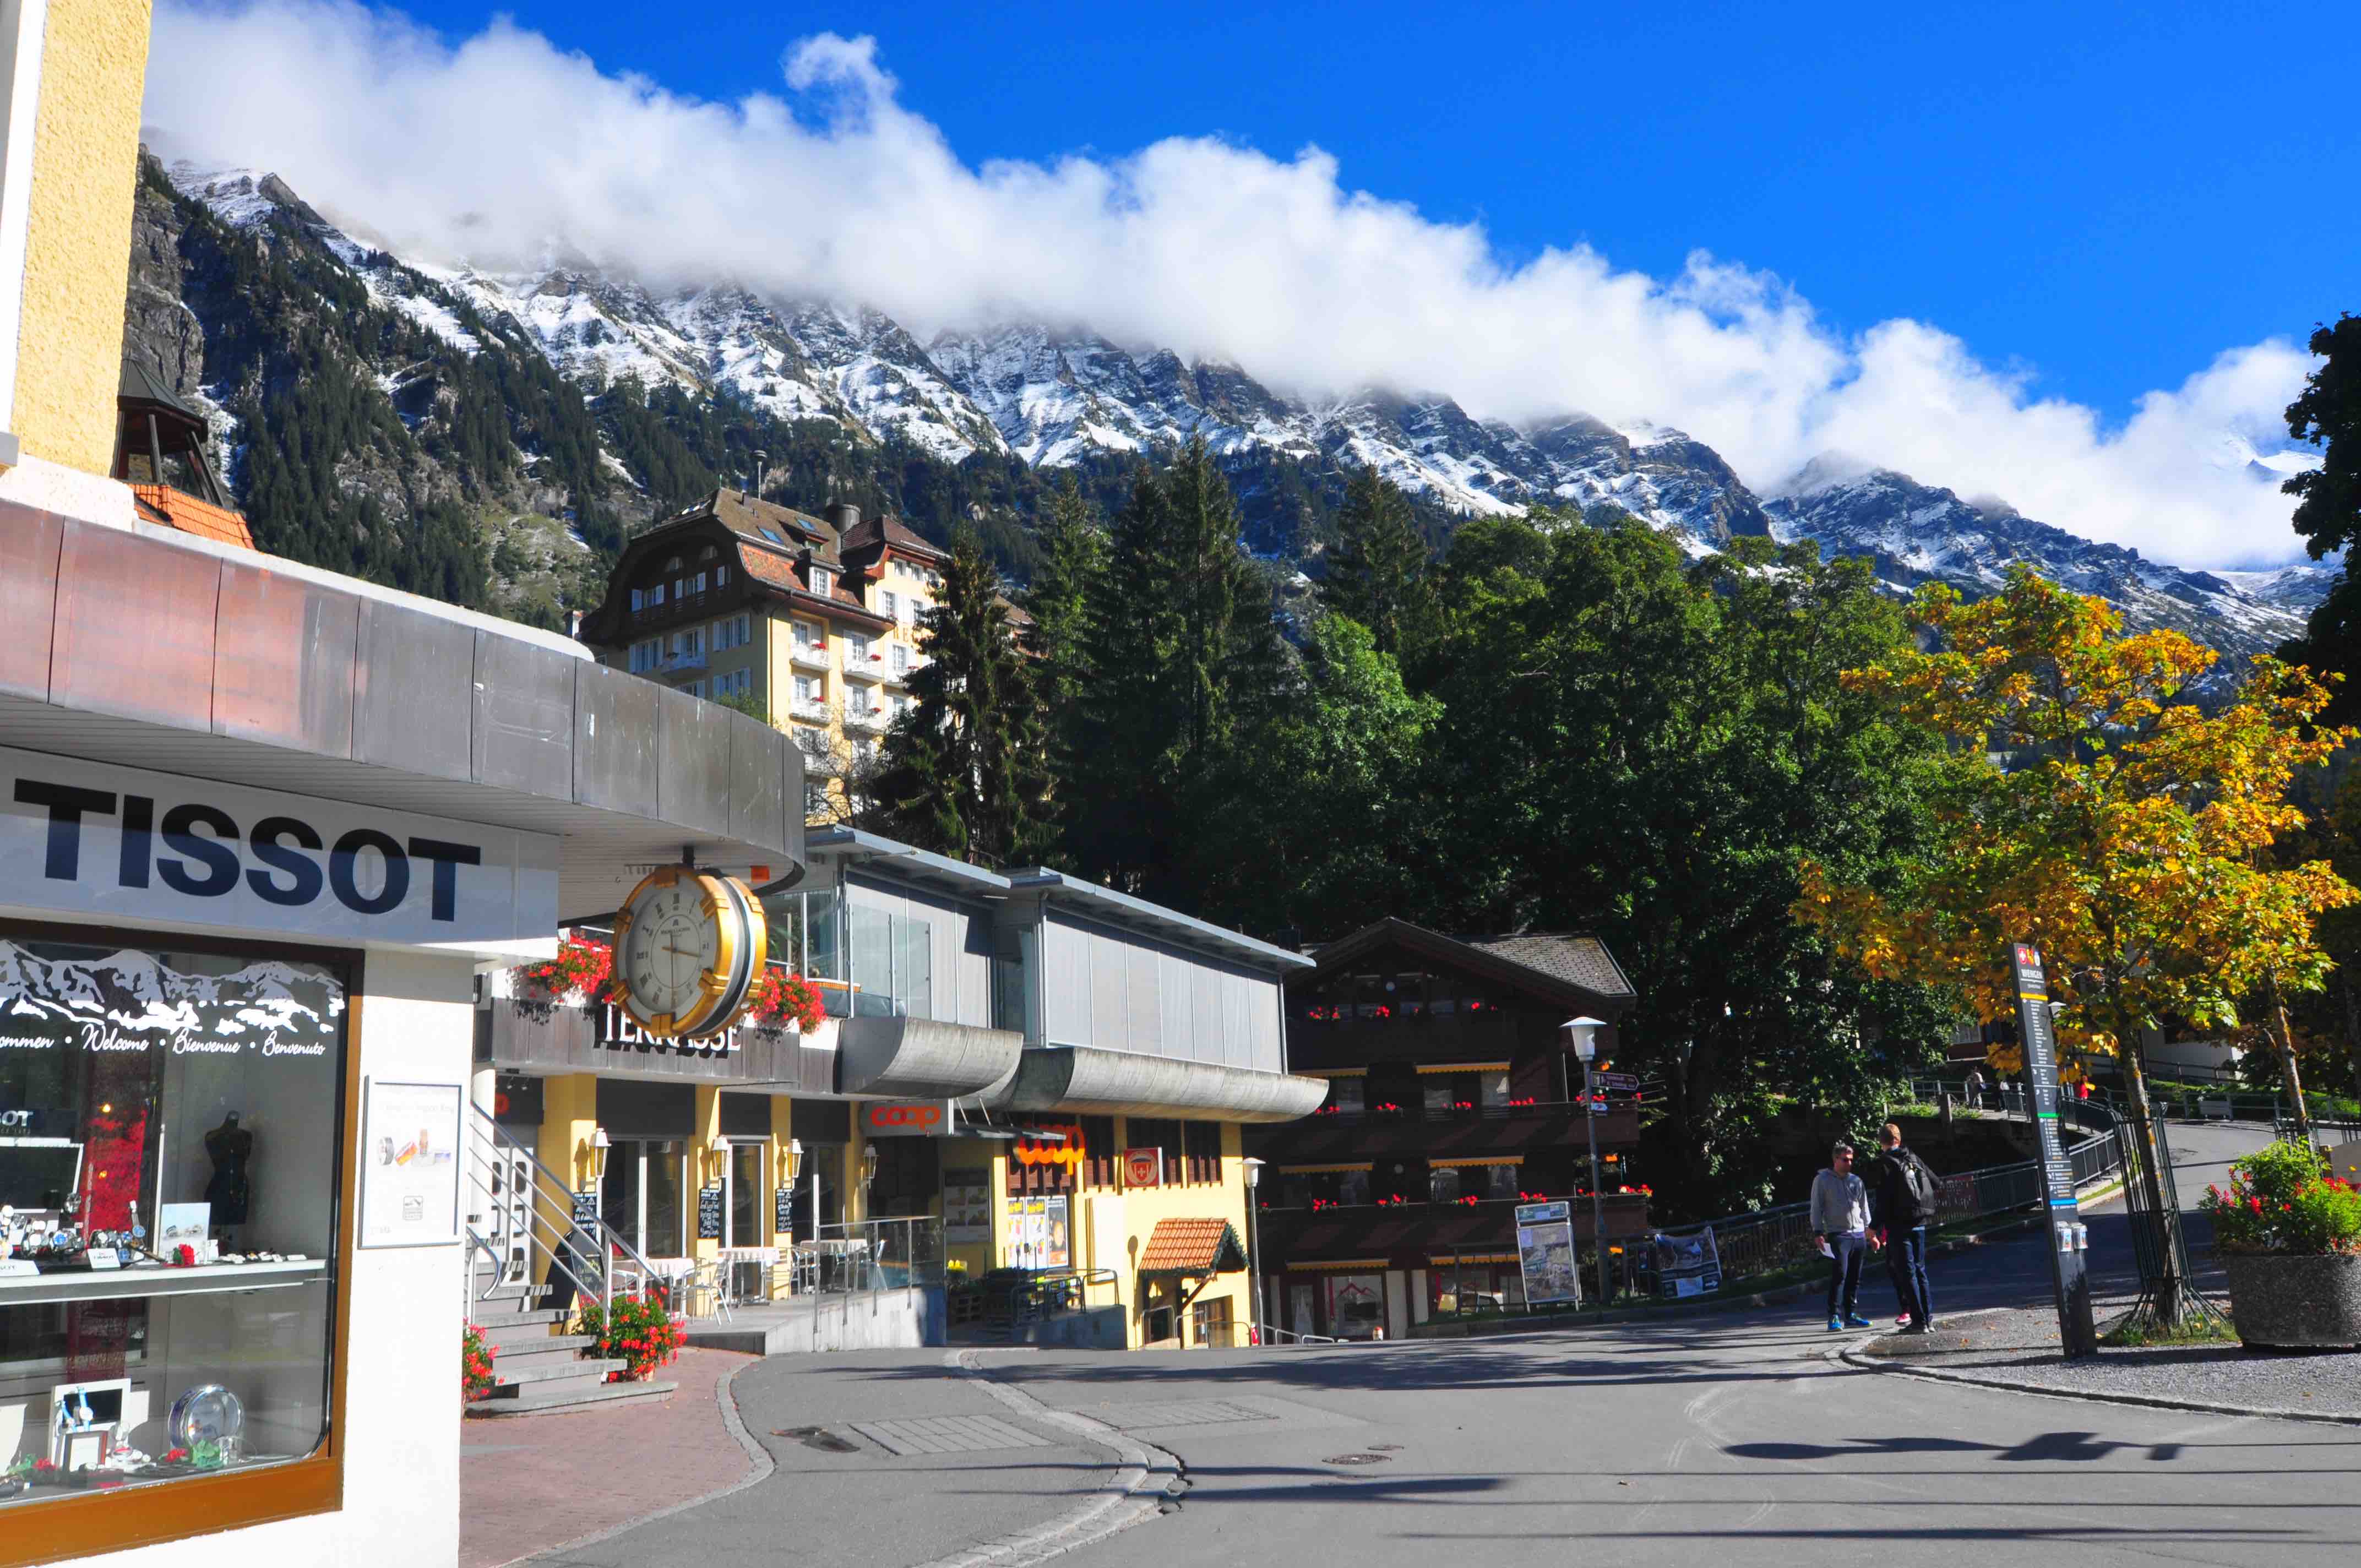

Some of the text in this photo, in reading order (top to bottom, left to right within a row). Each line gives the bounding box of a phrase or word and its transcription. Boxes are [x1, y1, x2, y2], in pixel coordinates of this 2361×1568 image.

[14, 778, 481, 922] TISSOT
[81, 1023, 149, 1052] Welcome
[172, 1027, 241, 1054] Bienvenue
[262, 1030, 325, 1056] Benvenuto
[603, 1003, 741, 1052] TERSE
[870, 1107, 940, 1131] coop
[1014, 1123, 1085, 1175] coop
